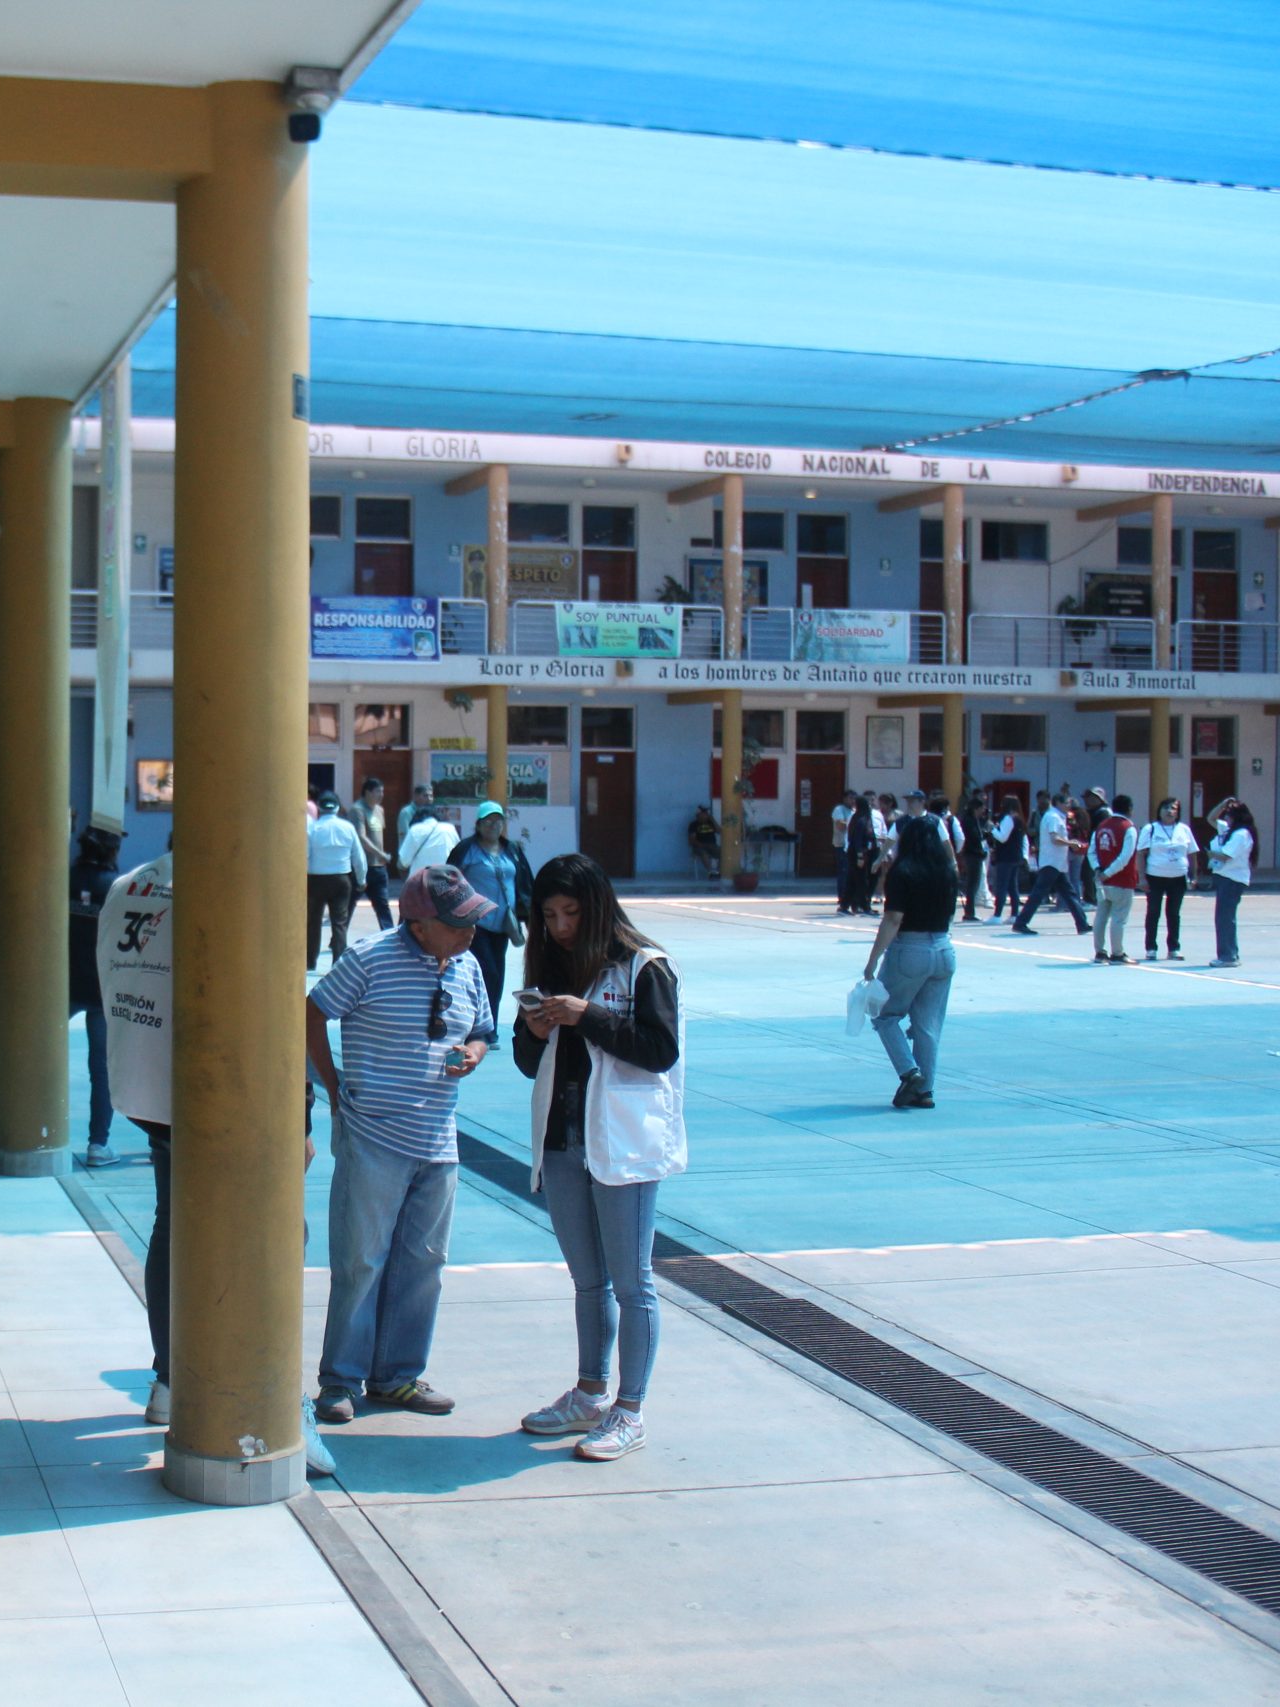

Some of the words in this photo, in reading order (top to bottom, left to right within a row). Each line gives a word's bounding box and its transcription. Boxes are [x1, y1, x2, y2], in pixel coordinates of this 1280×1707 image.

[308, 433, 335, 453] OR
[406, 436, 482, 459] GLORIA
[704, 450, 772, 470] COLEGIO
[802, 453, 891, 475] NACIONAL
[920, 461, 940, 478] DE
[969, 462, 990, 480] LA
[1148, 473, 1267, 495] INDEPENDENCIA
[507, 567, 561, 583] ESPETO
[314, 612, 435, 629] RESPONSABILIDAD
[576, 612, 599, 623] SOY
[606, 613, 660, 624] PUNTUAL
[816, 627, 884, 638] SOLIDARIDAD
[478, 657, 523, 677] Loor
[530, 664, 539, 680] y
[545, 658, 605, 677] Gloria
[658, 666, 668, 679] a
[674, 663, 700, 680] los
[705, 664, 777, 682] hombres
[783, 665, 801, 681] de
[807, 664, 868, 683] Antaño
[873, 669, 900, 686] que
[907, 671, 967, 685] crearon
[972, 671, 1033, 686] nuestra
[1082, 671, 1120, 688] Aula
[1126, 672, 1197, 690] Inmortal
[133, 1012, 163, 1029] 2026
